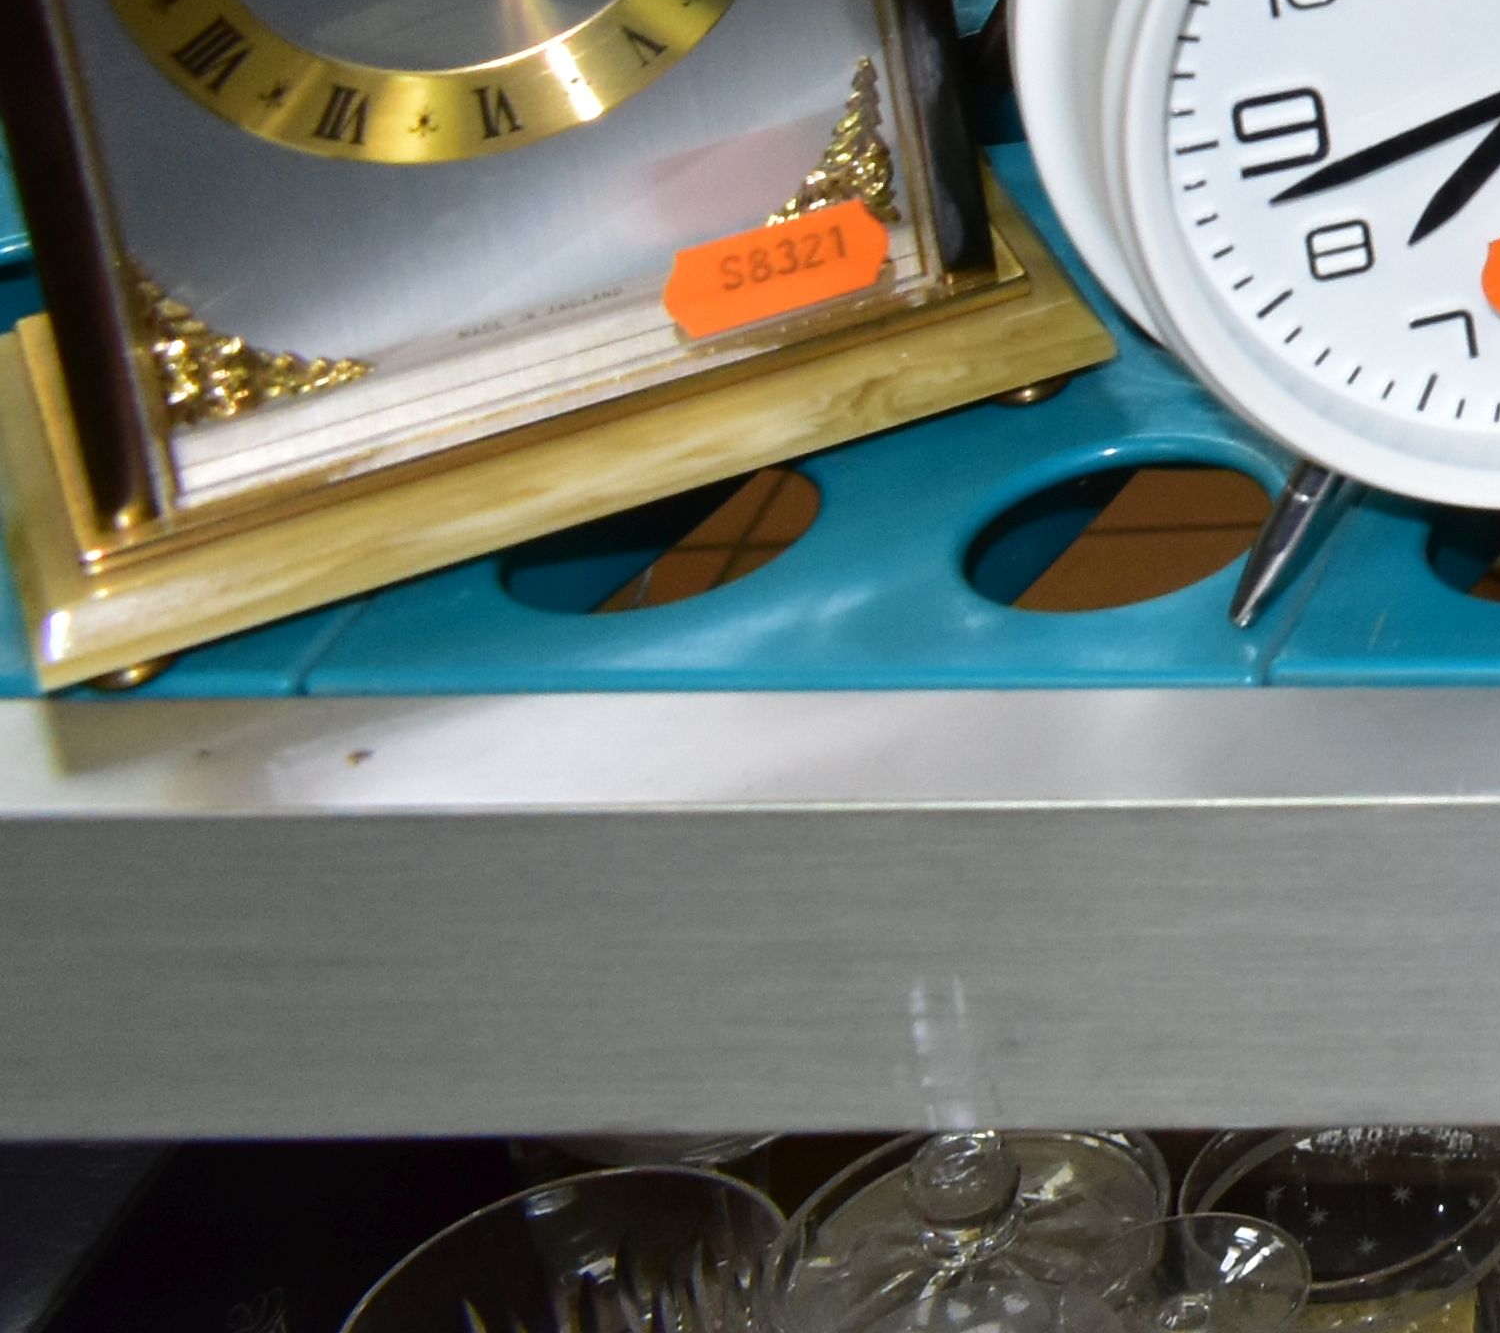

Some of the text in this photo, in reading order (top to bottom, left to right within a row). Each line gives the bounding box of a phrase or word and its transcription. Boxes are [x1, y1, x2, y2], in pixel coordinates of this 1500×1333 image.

[172, 15, 254, 95] VIII
[618, 24, 668, 69] V
[311, 84, 371, 147] VII
[474, 85, 523, 141] VI
[1231, 87, 1331, 180] 9
[719, 224, 849, 292] S8321
[1304, 218, 1375, 282] 8
[1409, 308, 1480, 360] 7
